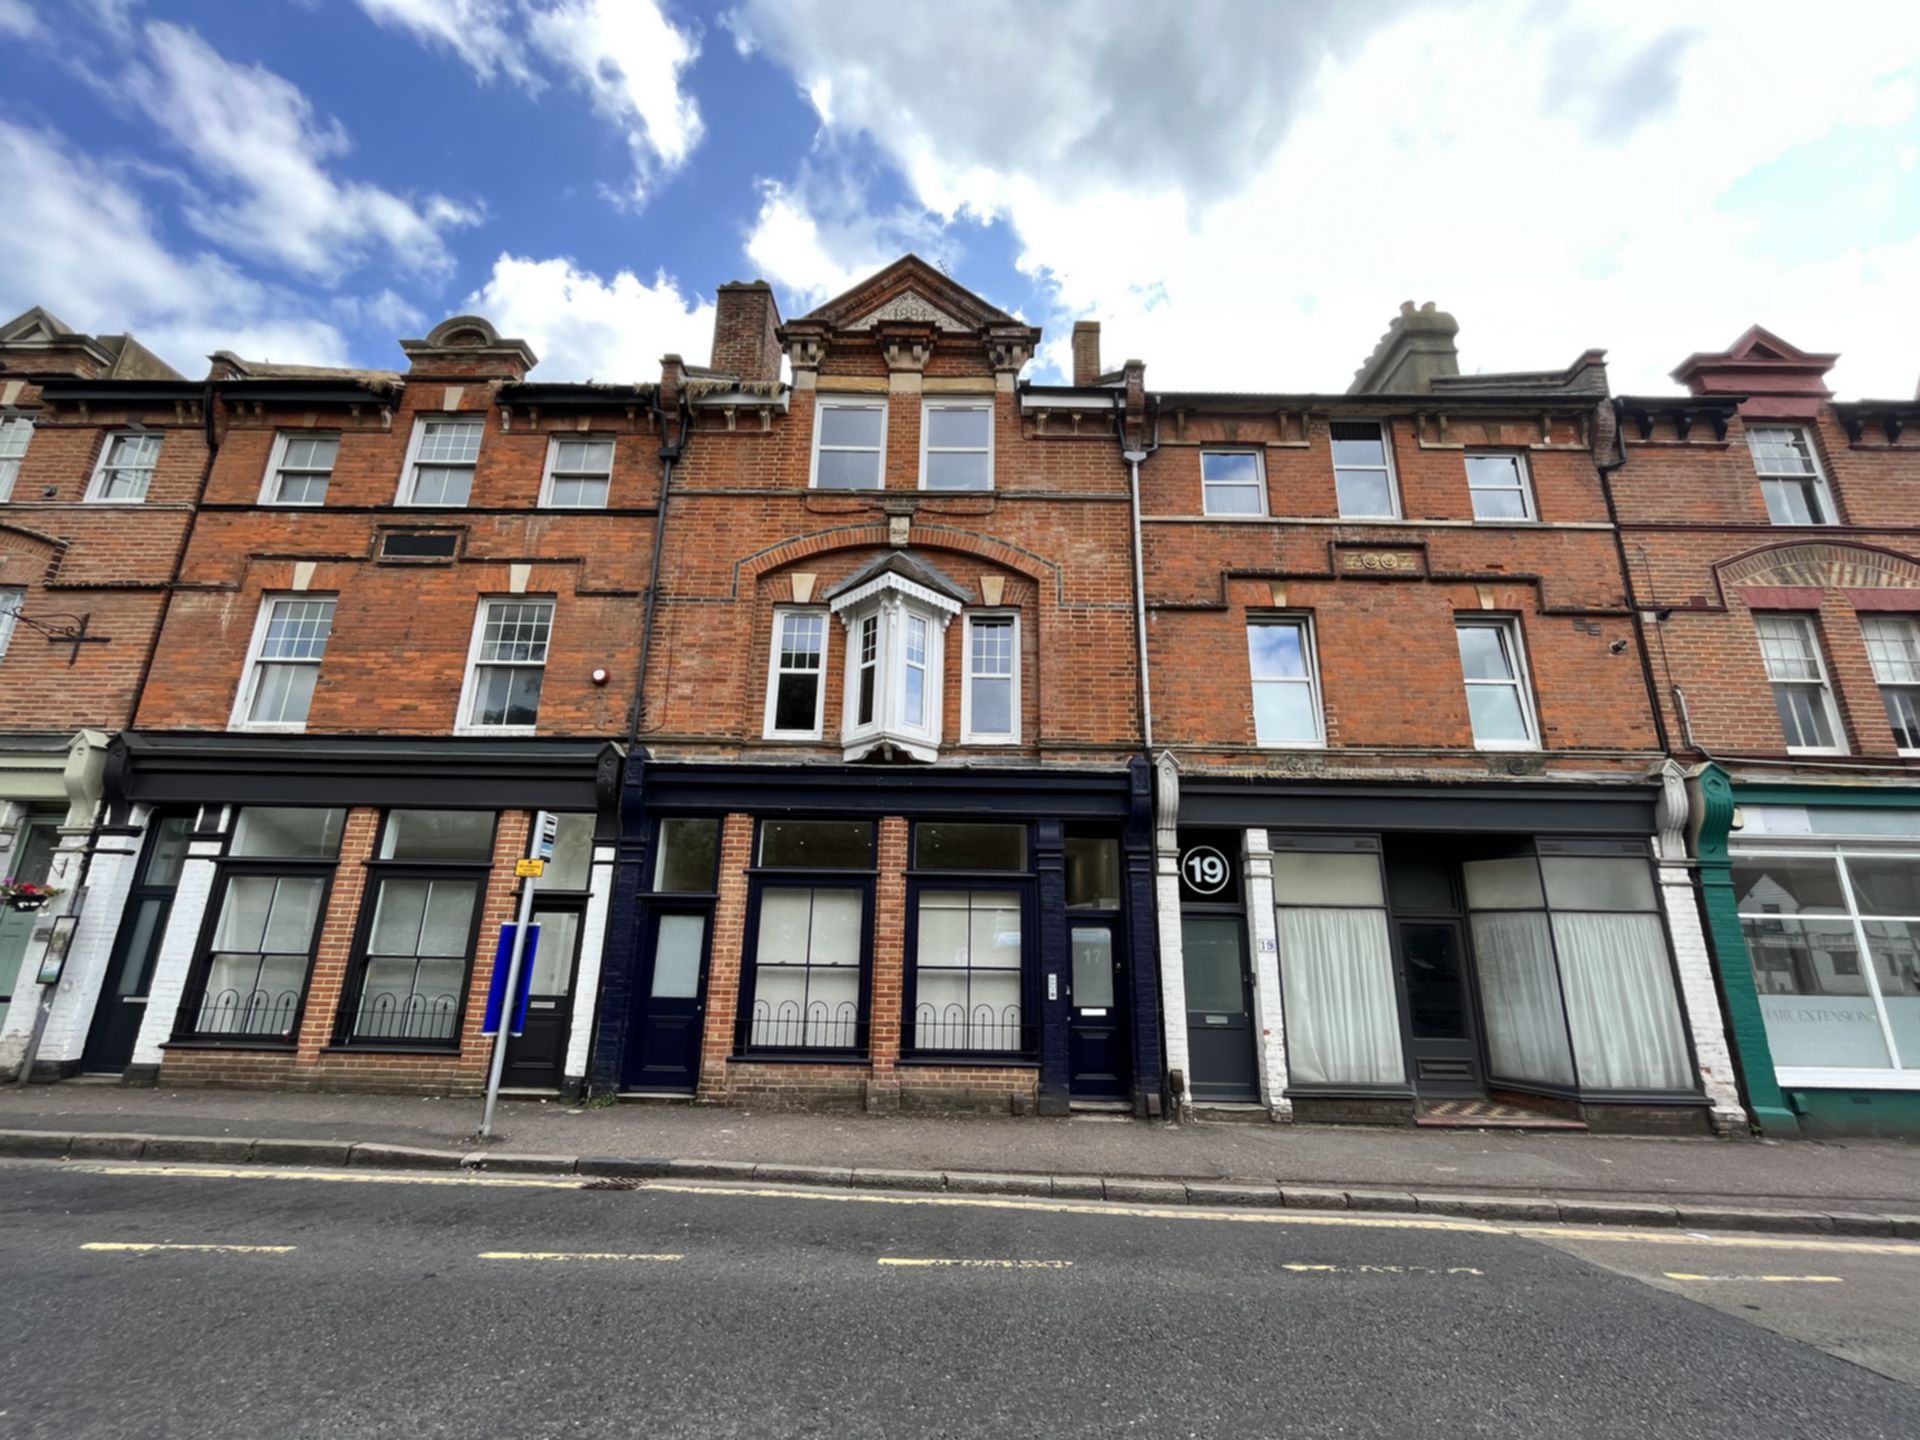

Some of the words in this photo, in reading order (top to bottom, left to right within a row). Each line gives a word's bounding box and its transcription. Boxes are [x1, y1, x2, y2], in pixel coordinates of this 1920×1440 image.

[1188, 856, 1224, 884] 19
[1260, 940, 1274, 951] 19
[1082, 949, 1102, 964] 17
